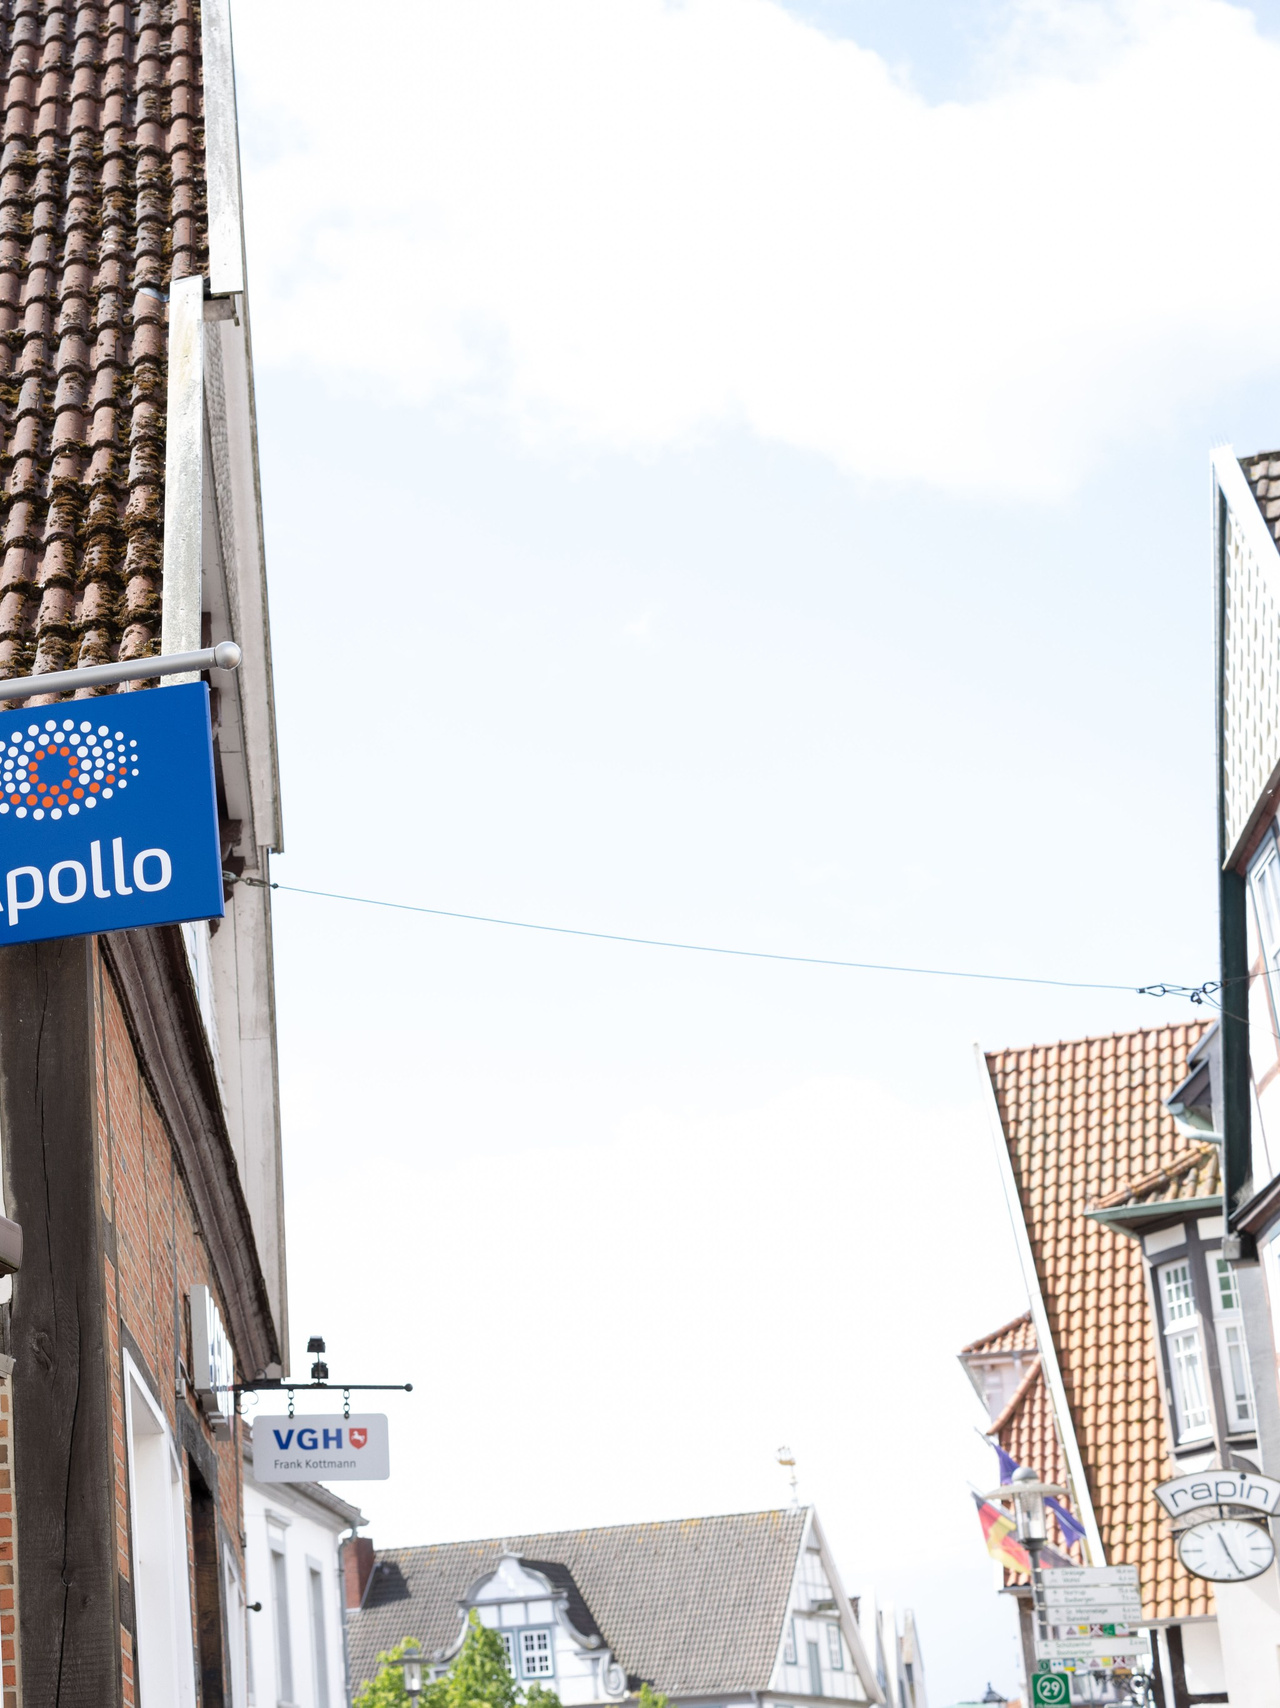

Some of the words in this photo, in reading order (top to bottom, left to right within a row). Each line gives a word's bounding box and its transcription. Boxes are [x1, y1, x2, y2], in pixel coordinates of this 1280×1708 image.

[273, 1427, 343, 1450] VGH
[274, 1458, 303, 1469] Frank
[305, 1458, 357, 1469] Kottmann
[1170, 1472, 1270, 1508] rapin
[1041, 1680, 1061, 1697] 29
